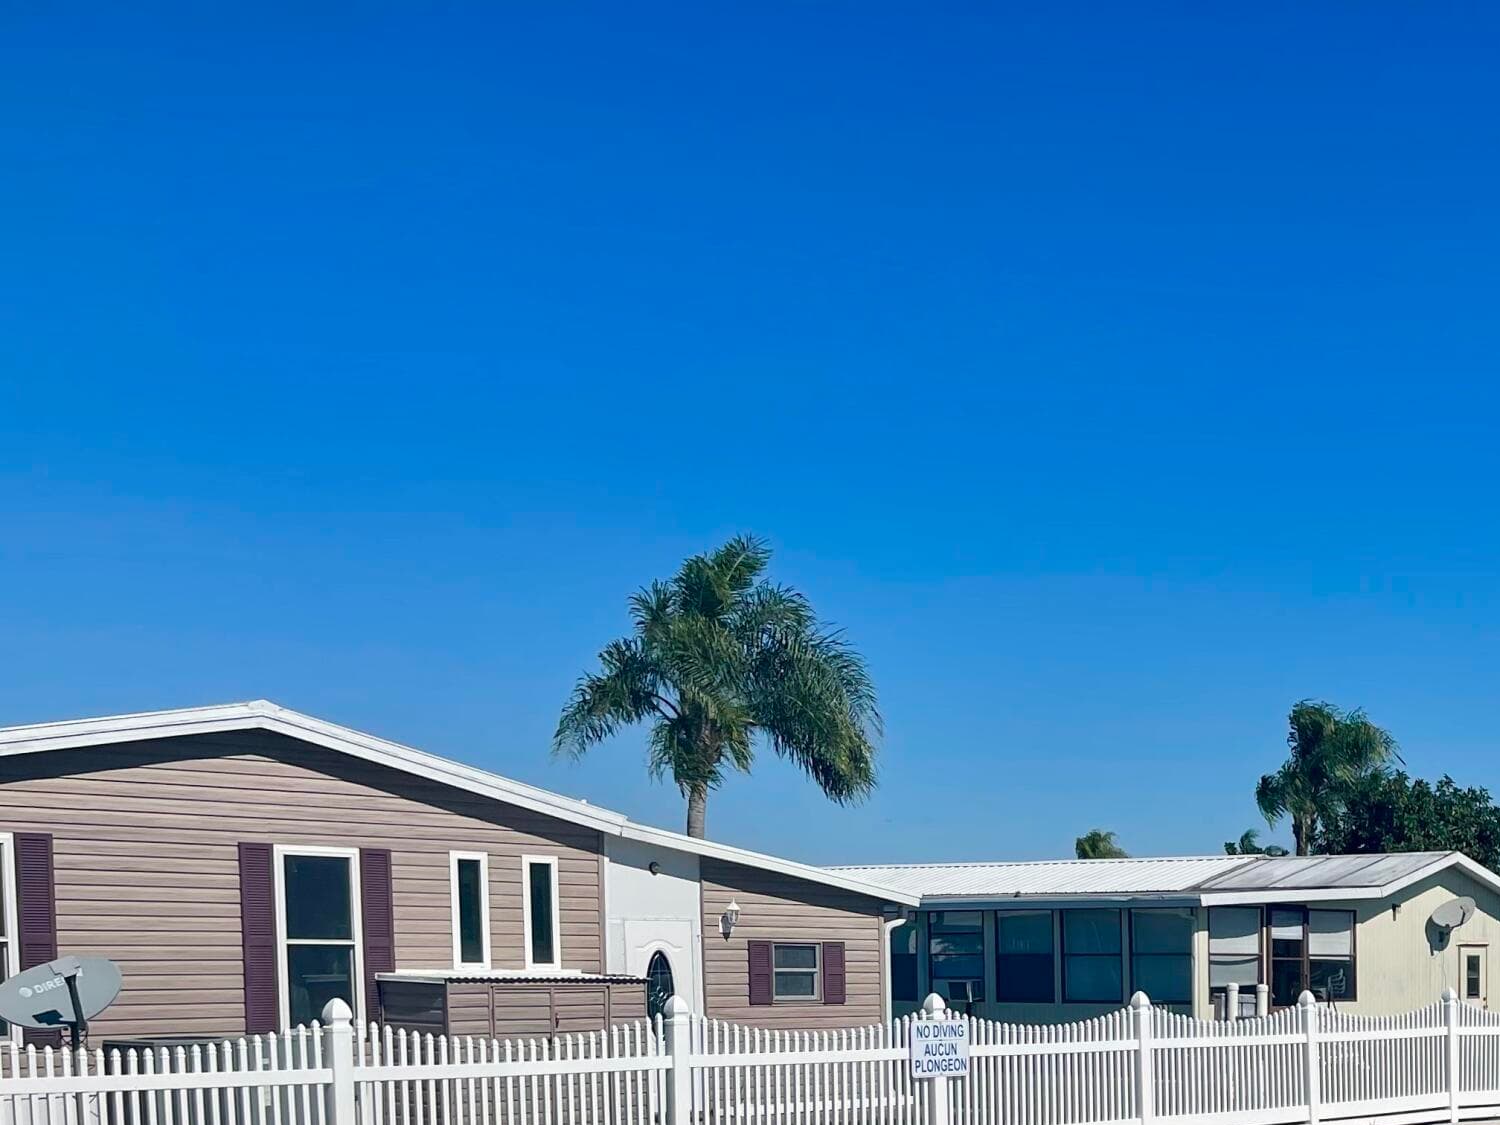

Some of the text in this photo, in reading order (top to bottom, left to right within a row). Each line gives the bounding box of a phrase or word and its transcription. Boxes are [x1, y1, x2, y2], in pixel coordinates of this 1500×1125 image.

[916, 1024, 964, 1038] NO DIVING
[924, 1043, 957, 1056] AUCUN
[915, 1058, 967, 1073] PLONGEON
